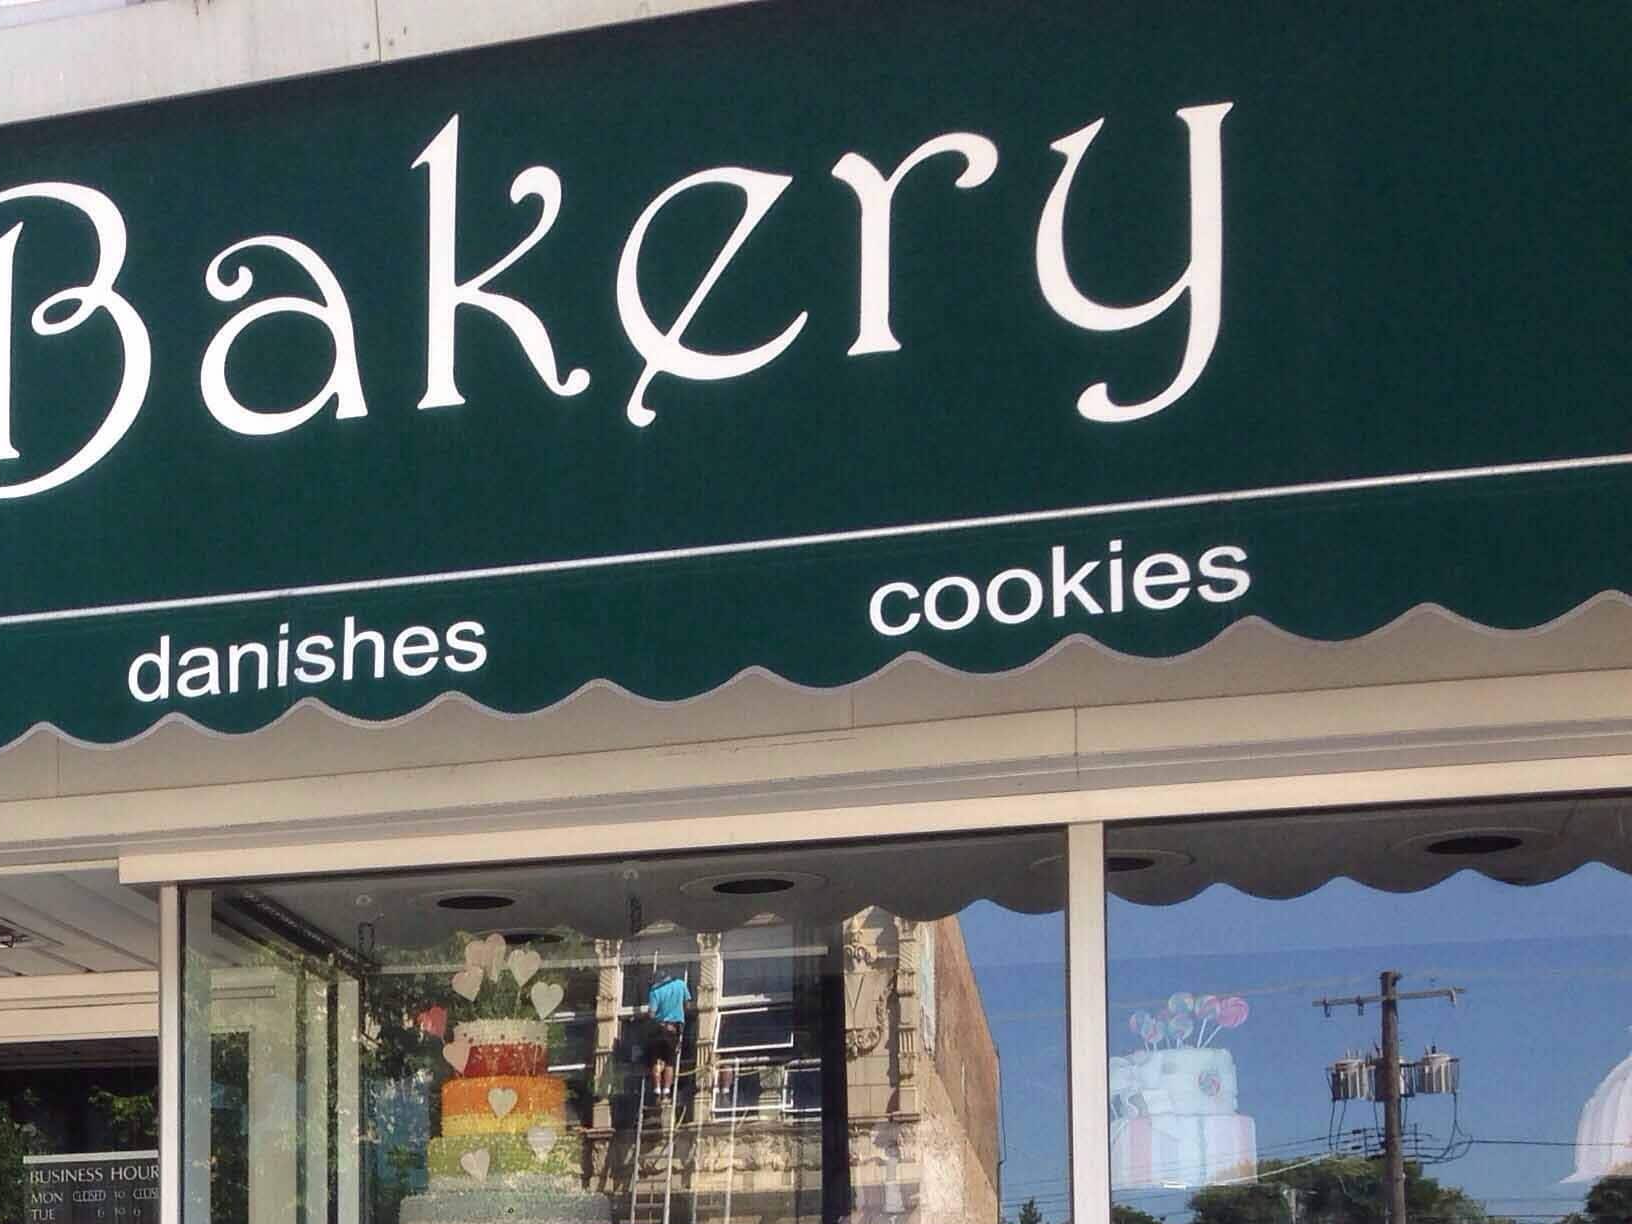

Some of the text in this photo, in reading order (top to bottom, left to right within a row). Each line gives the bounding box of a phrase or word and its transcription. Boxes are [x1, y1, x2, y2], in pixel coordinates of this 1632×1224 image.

[869, 539, 1251, 636] cookies
[127, 615, 488, 703] danishes
[30, 1165, 159, 1185] BUSINESS HOUR
[31, 1191, 64, 1204] MON
[31, 1209, 56, 1221] TUE
